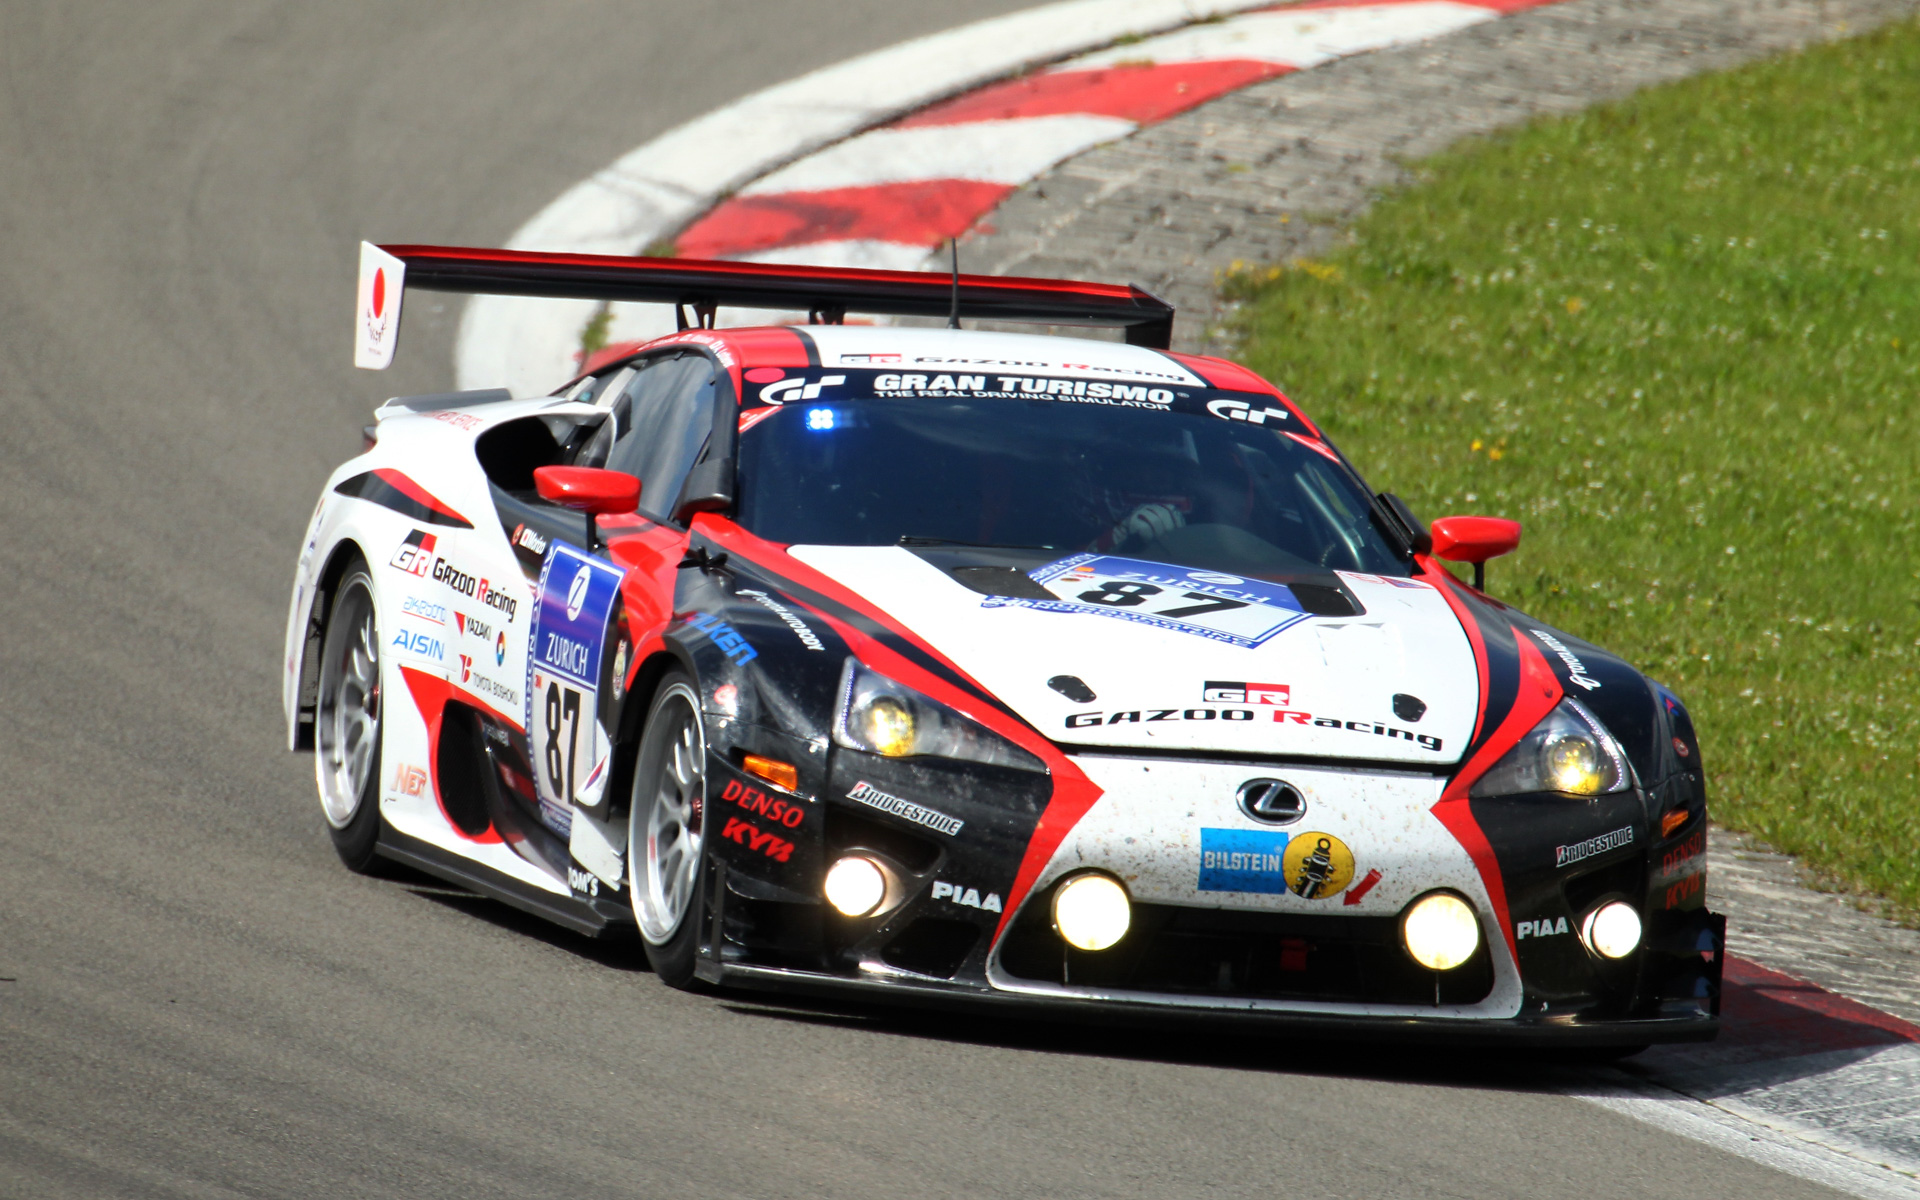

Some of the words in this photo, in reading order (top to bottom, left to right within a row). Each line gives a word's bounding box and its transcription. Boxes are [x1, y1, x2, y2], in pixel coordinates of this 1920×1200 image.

[874, 374, 985, 391] GRAN
[997, 377, 1175, 404] TURISMO
[874, 390, 915, 398] THE
[919, 390, 970, 398] REAL
[973, 391, 1055, 402] DRIVING
[1060, 394, 1172, 411] SIMULATOR
[477, 577, 518, 623] Racing
[1076, 580, 1252, 619] 87
[1120, 571, 1271, 604] ZURICH
[392, 628, 446, 662] AISIN
[544, 632, 590, 678] ZURICH
[545, 681, 581, 806] 87
[1065, 708, 1254, 730] GAZOO
[1273, 709, 1443, 752] Racing
[721, 779, 805, 829] DENSO
[845, 780, 965, 837] BRIDGESTONE
[1203, 850, 1280, 873] BILSTEIN
[1555, 825, 1634, 868] BRIDGESTONE
[1662, 831, 1702, 878] DENSO
[931, 880, 1003, 914] PIAA
[1516, 916, 1569, 941] PIAA
